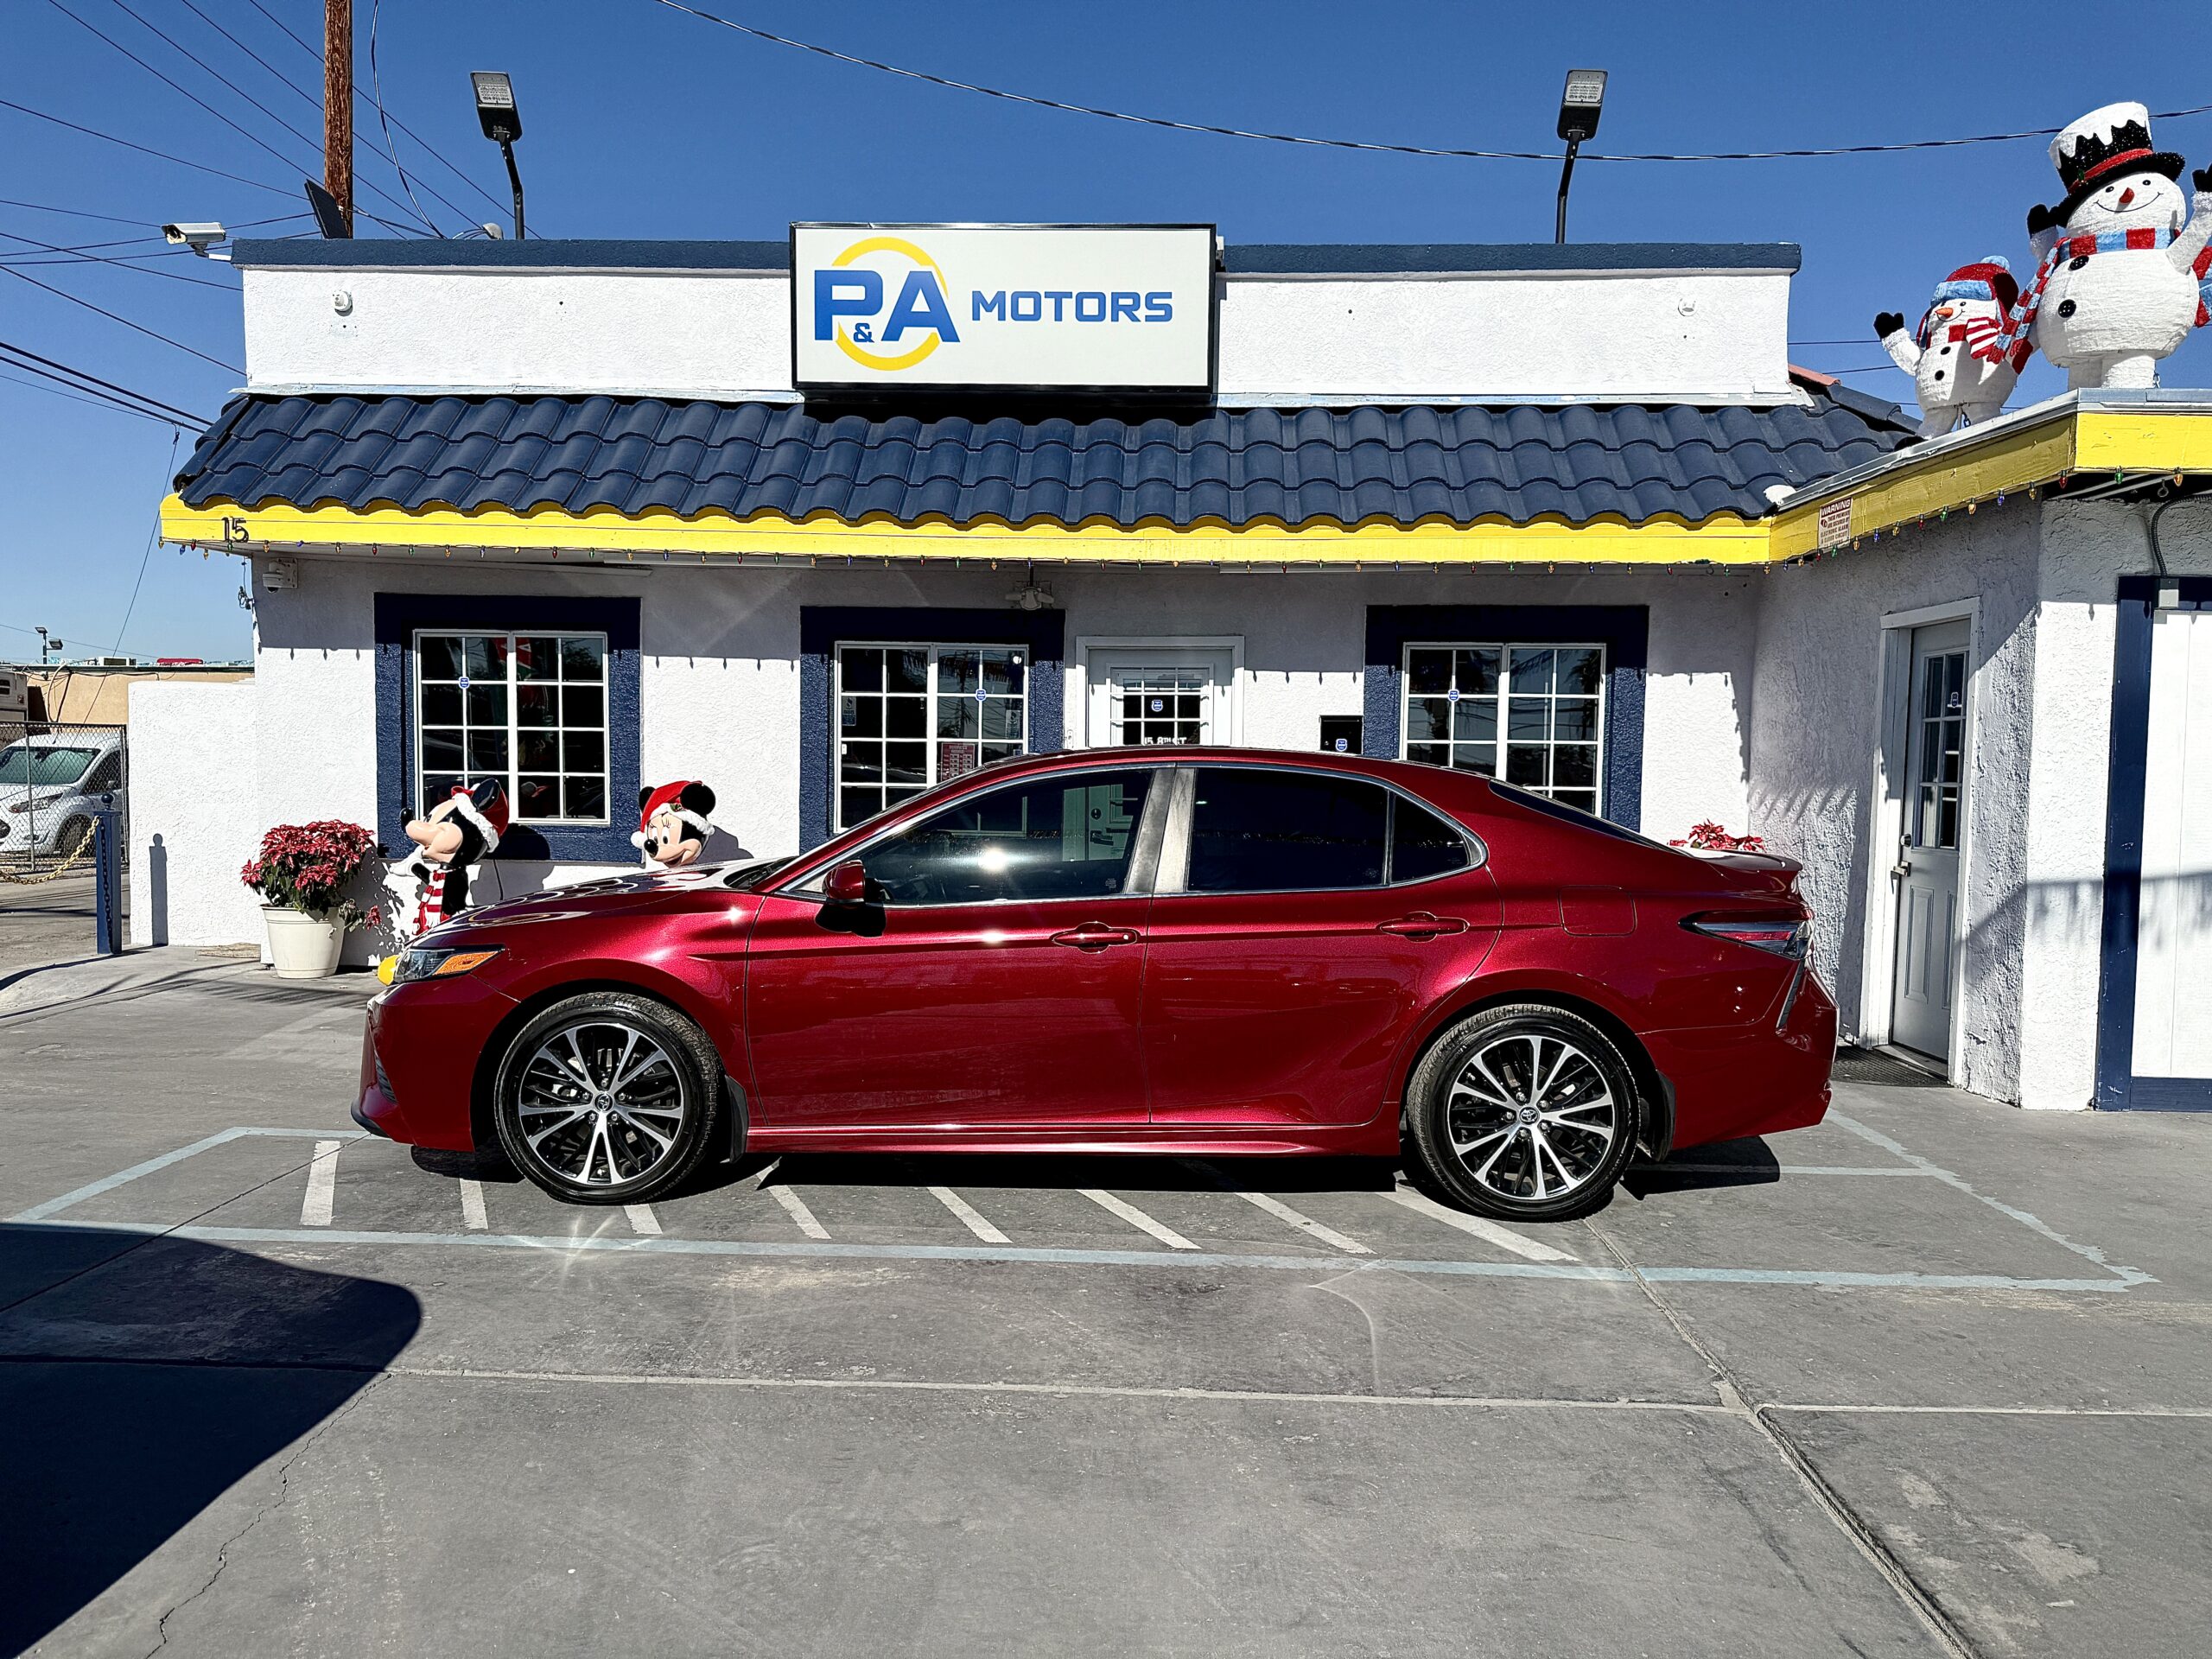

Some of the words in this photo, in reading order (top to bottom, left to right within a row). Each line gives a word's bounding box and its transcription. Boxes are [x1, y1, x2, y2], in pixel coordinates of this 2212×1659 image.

[971, 290, 1173, 322] MOTORS
[1821, 499, 1851, 516] WARNING
[222, 517, 249, 543] 15
